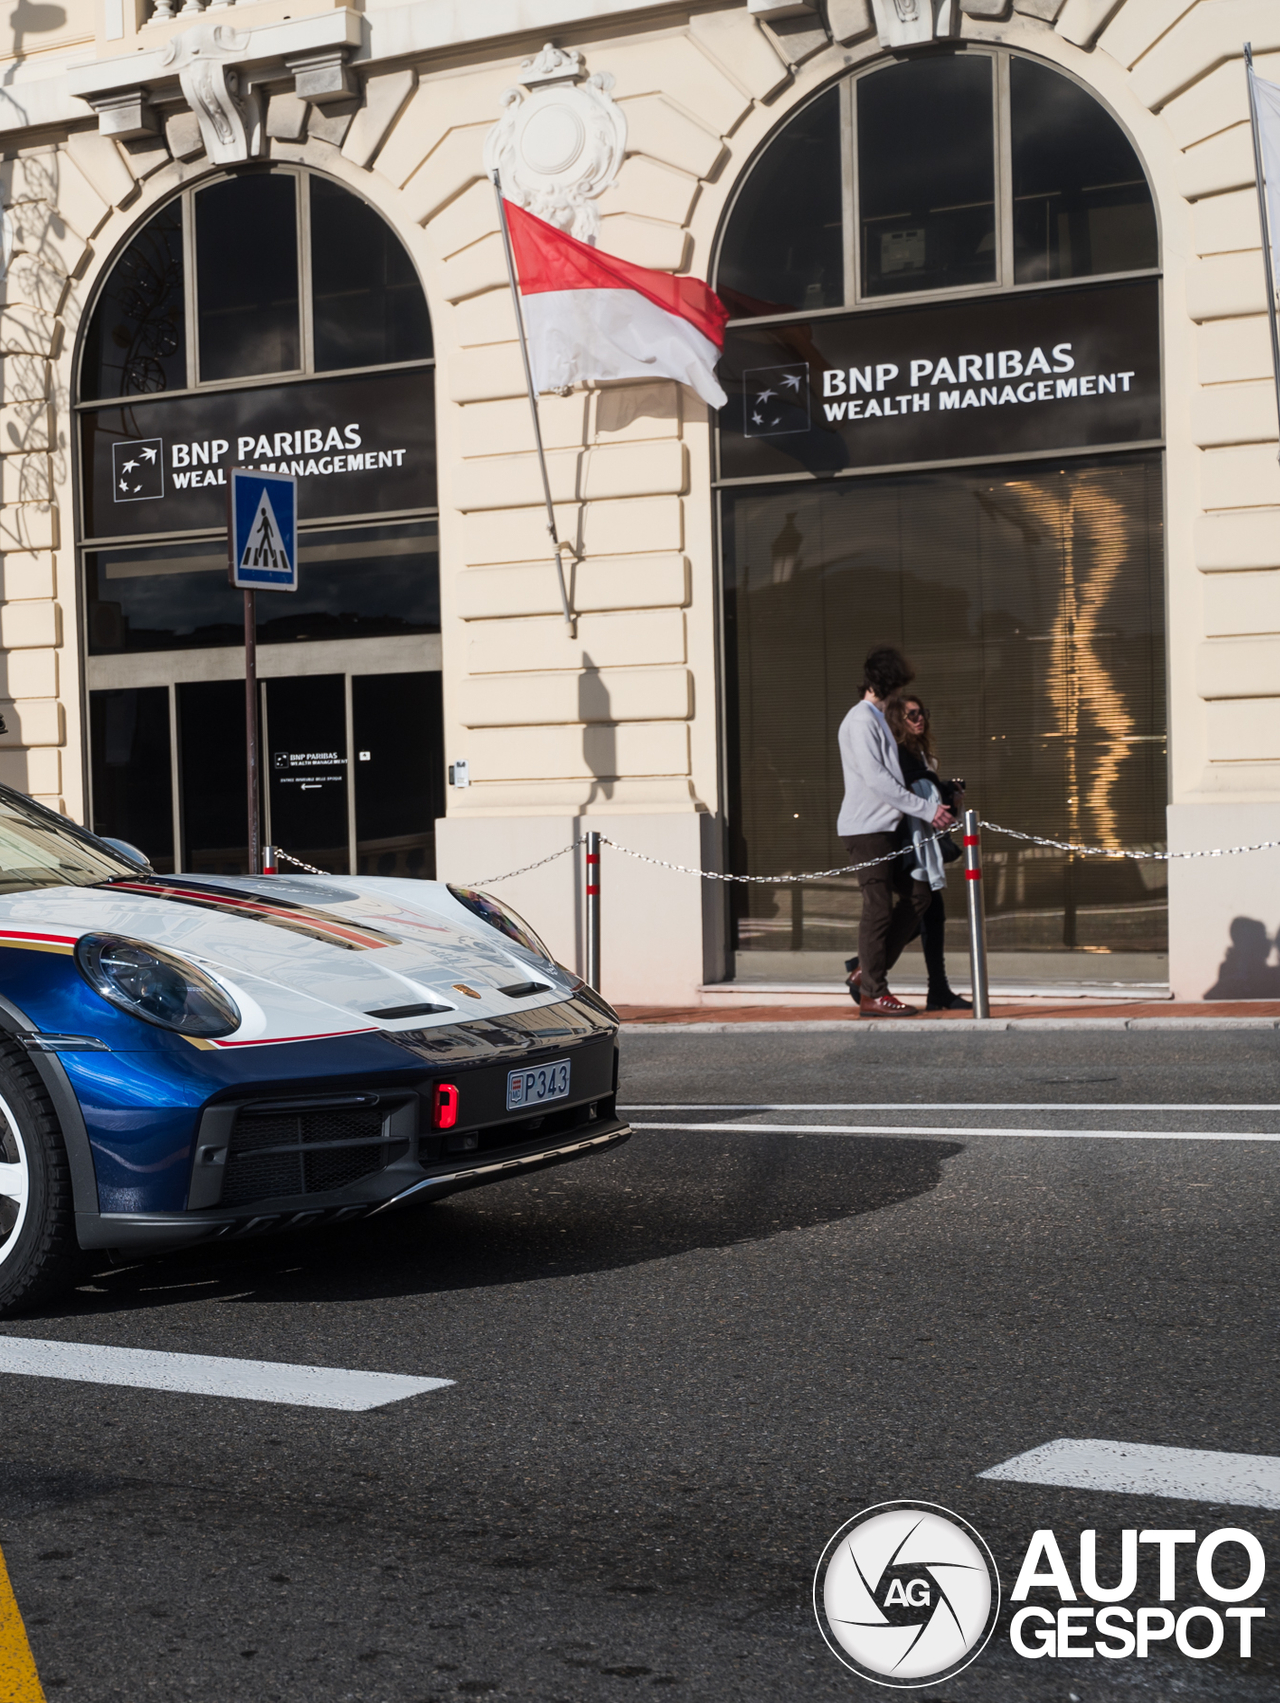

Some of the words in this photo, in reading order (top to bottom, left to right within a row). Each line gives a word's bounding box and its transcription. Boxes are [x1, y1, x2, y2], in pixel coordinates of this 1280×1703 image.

[823, 363, 899, 397] BNP
[910, 343, 1075, 387] PARIBAS
[823, 391, 930, 422] WEALTH
[938, 371, 1135, 411] MANAGEMENT
[172, 439, 229, 468] BNP
[237, 423, 362, 461] PARIBAS
[172, 464, 254, 489] WEAL
[260, 449, 406, 477] MANAGEMENT
[306, 752, 338, 760] PARIBAS
[512, 1090, 521, 1098] MC
[525, 1065, 568, 1102] P343
